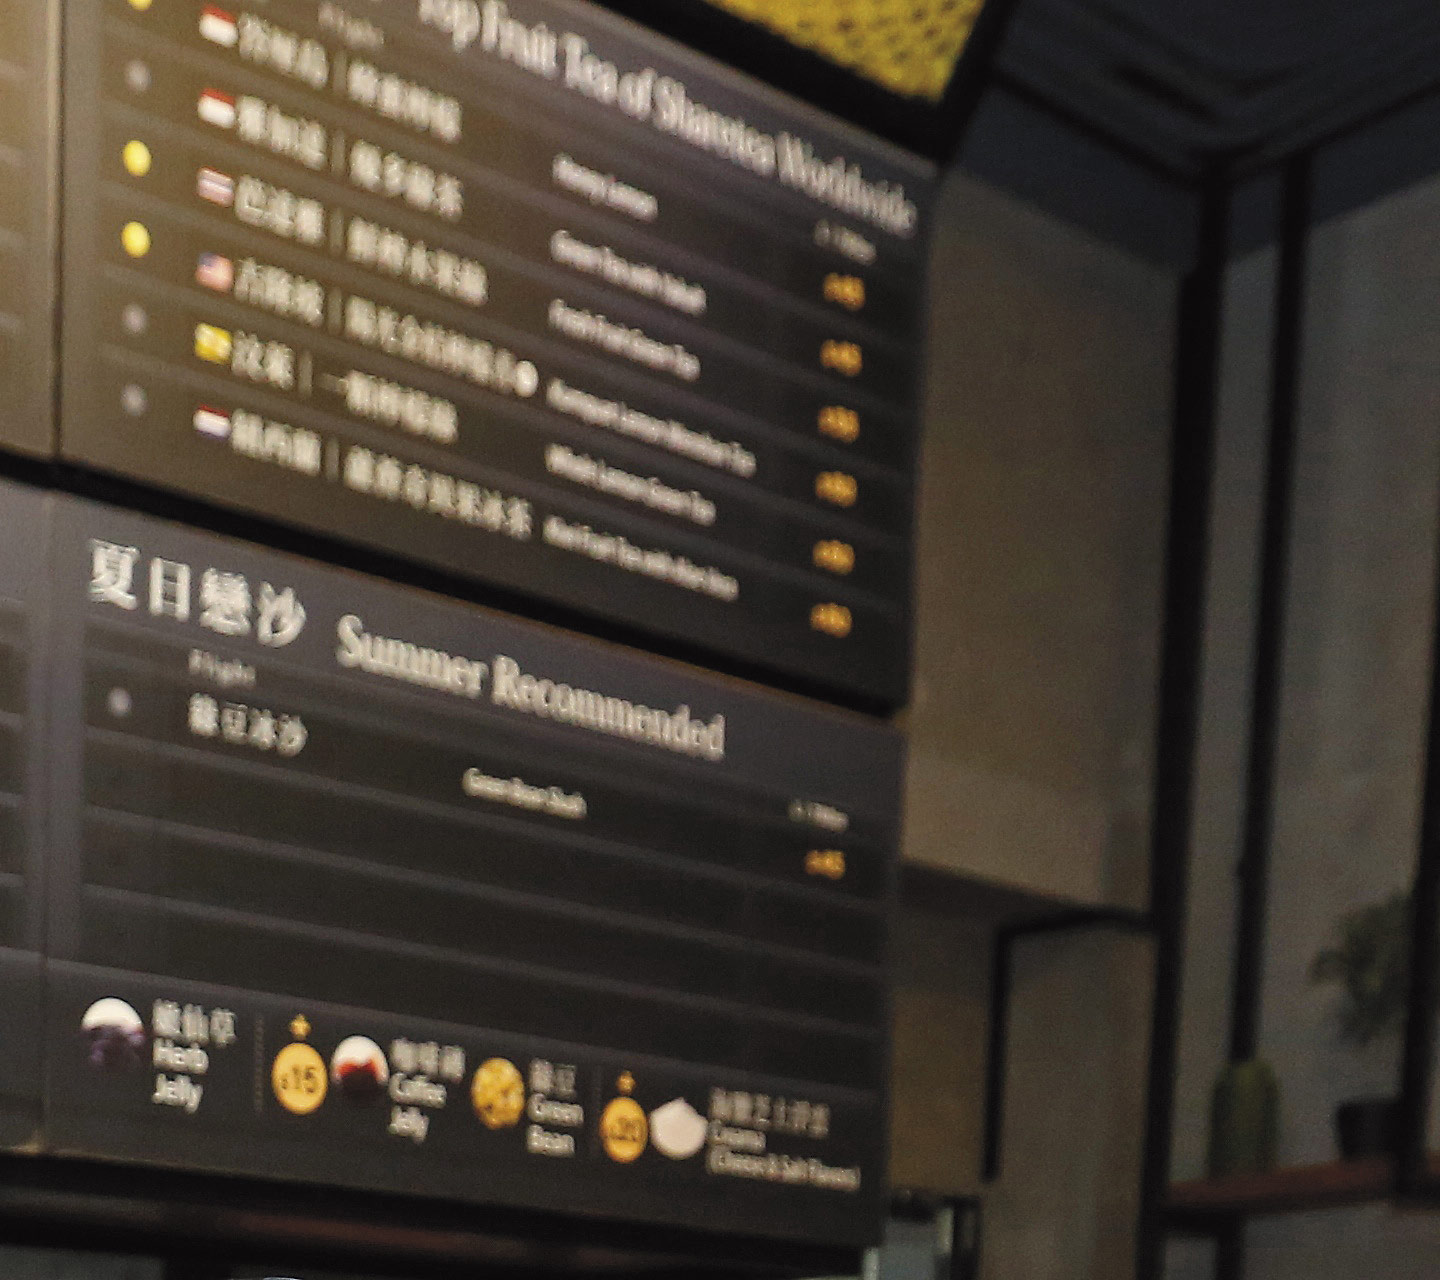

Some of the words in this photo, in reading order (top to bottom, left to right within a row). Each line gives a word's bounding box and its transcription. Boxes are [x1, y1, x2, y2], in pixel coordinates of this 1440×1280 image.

[481, 0, 560, 80] Fruit
[560, 31, 620, 105] Tea
[336, 613, 488, 699] Summer
[491, 653, 727, 762] Recommended
